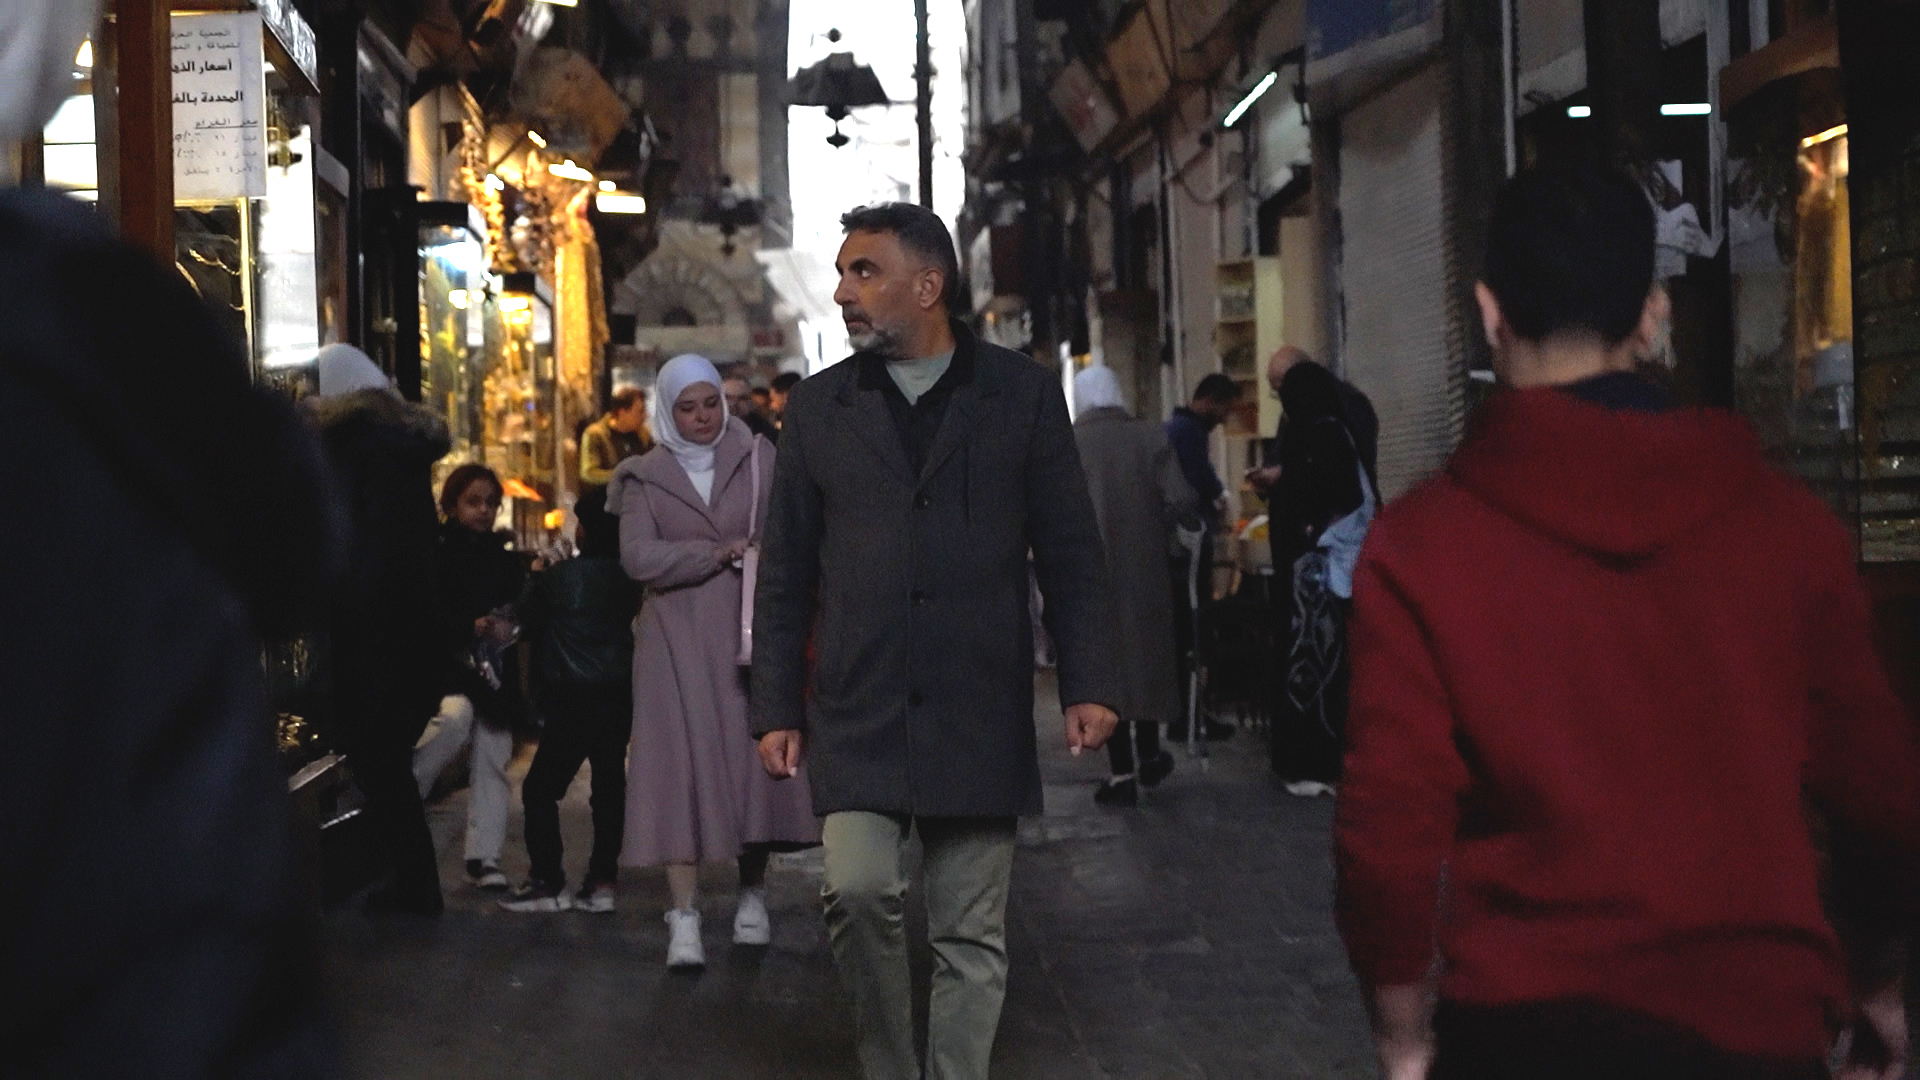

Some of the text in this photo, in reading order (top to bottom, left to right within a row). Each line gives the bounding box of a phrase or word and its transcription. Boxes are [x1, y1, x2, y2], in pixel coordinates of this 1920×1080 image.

[199, 57, 232, 75] أسعار
[201, 89, 243, 103] المحددة
[195, 117, 231, 129] الغرام
